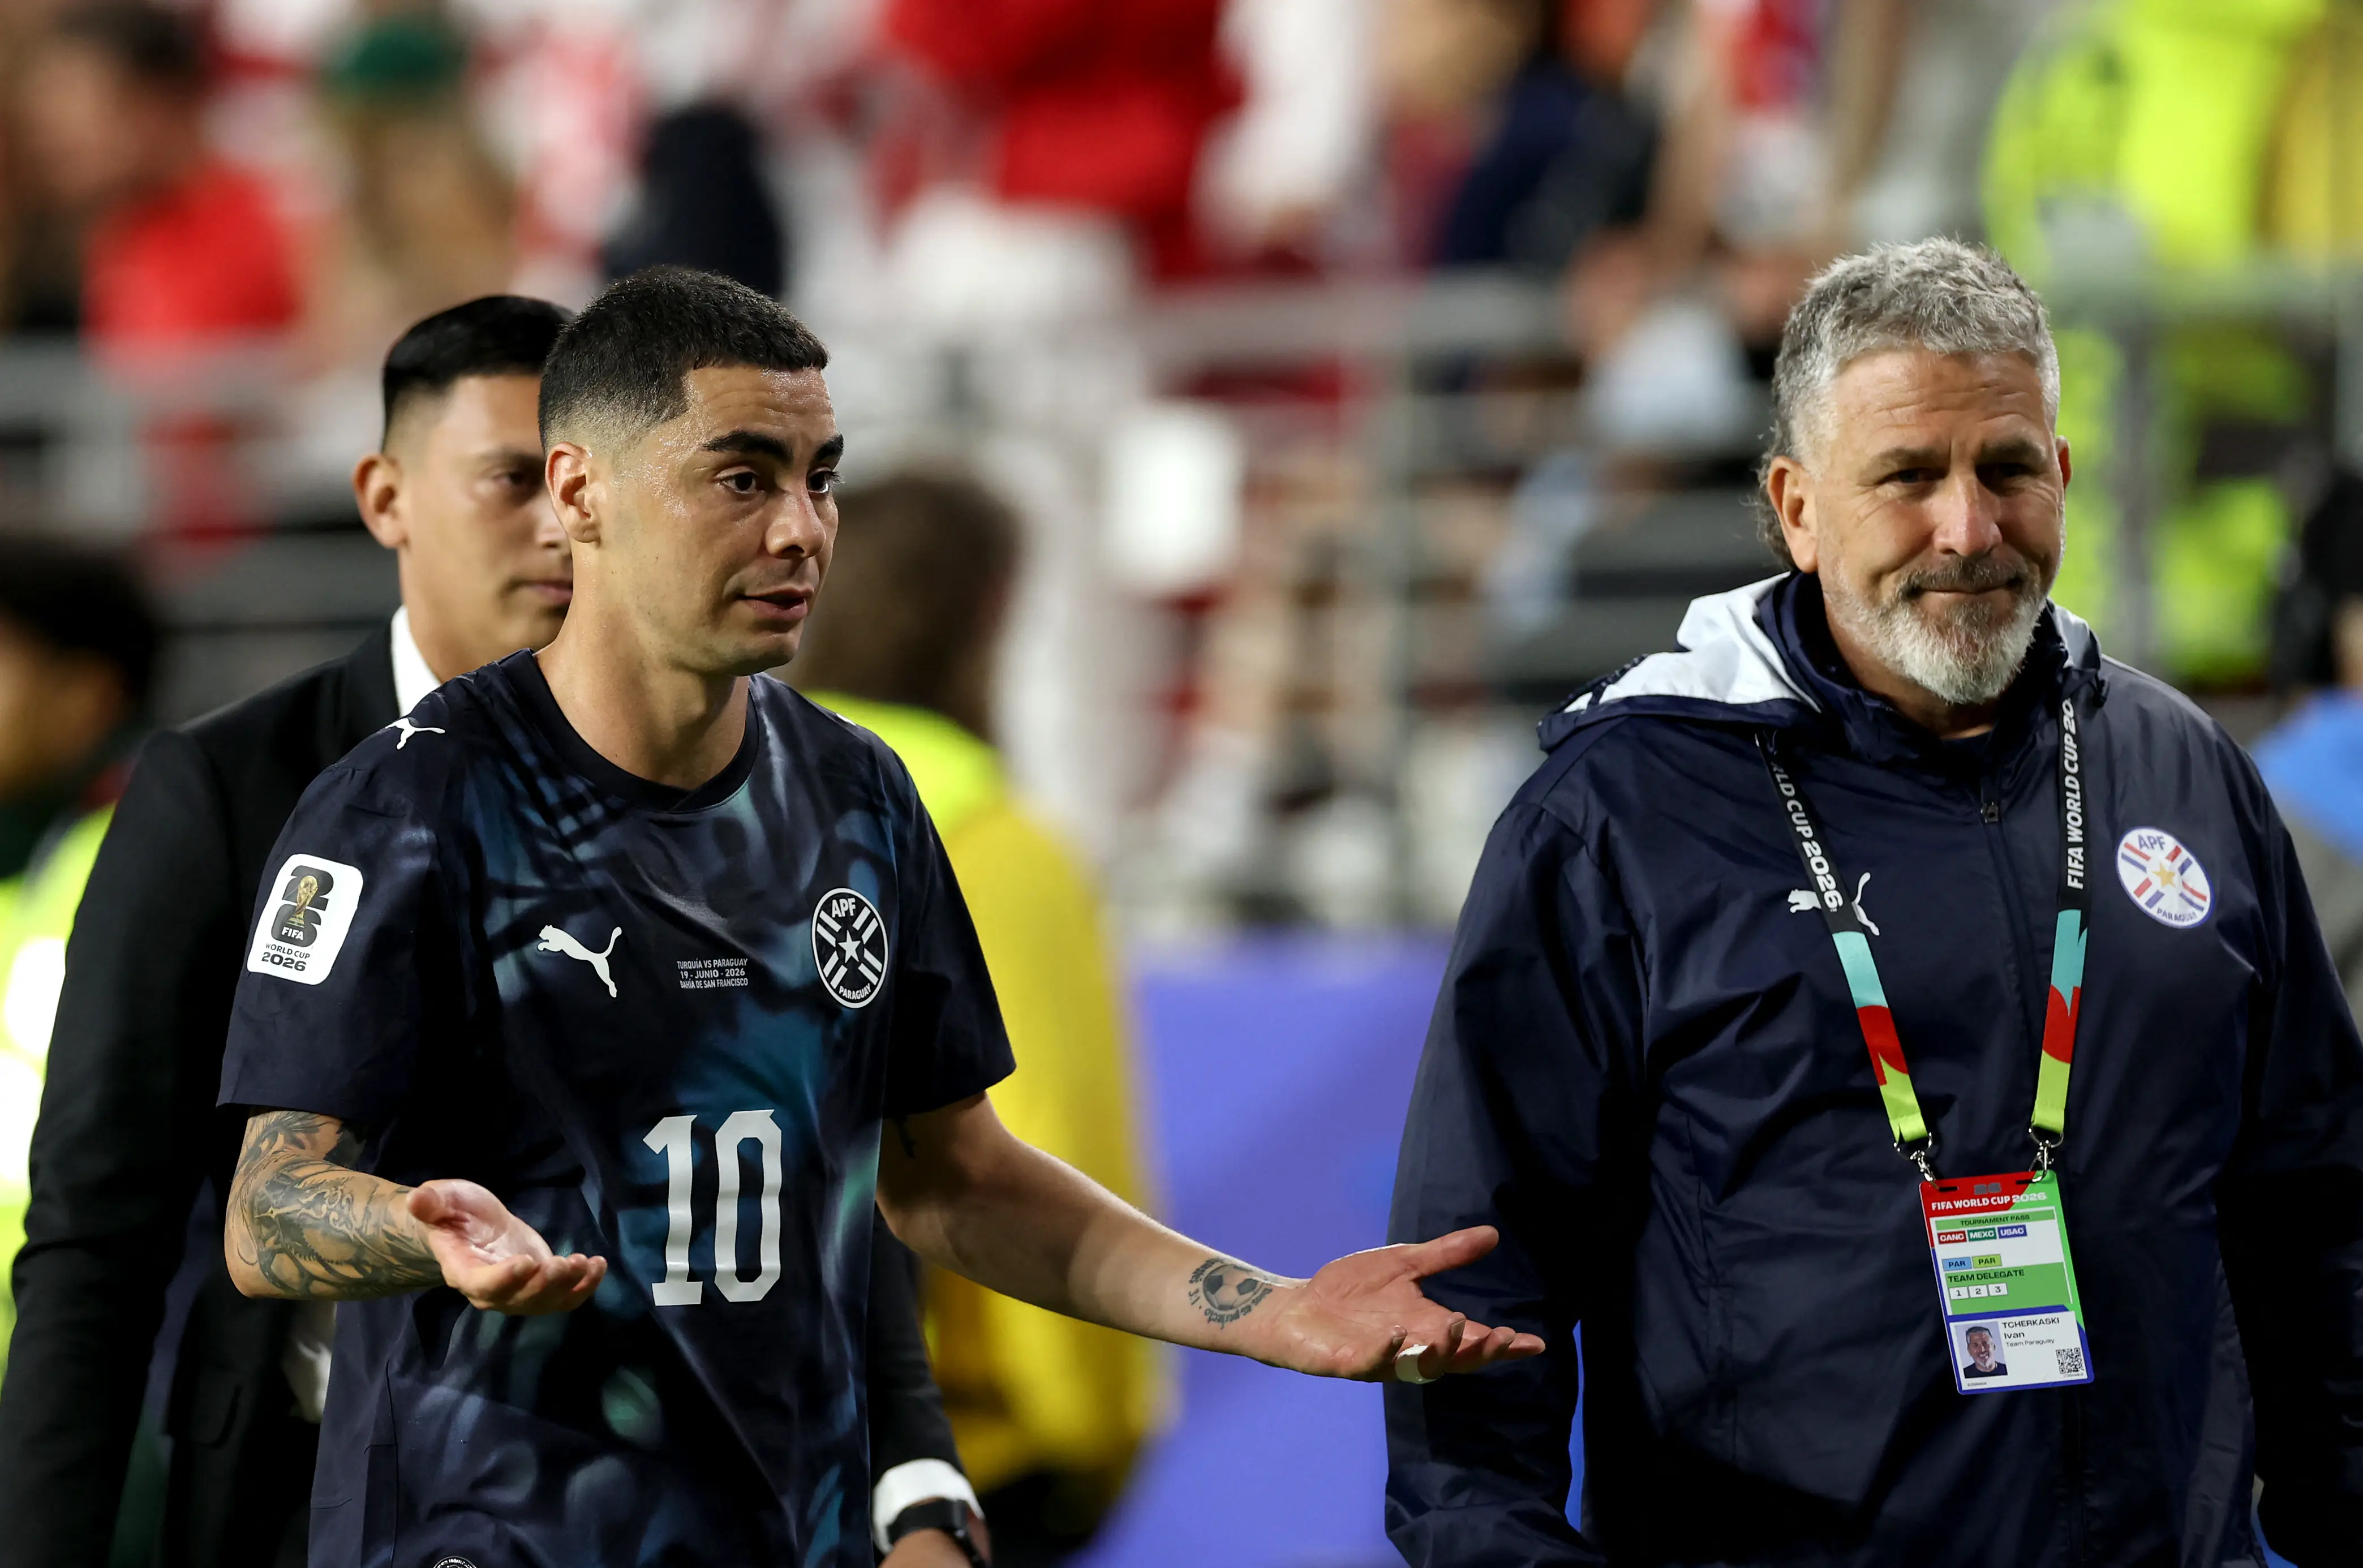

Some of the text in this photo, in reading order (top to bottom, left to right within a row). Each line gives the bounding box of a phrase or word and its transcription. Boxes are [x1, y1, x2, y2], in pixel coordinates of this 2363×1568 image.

[2063, 698, 2084, 890] FIFA WORLD CUP 20
[2137, 834, 2166, 850] APF
[1786, 800, 1814, 839] CUP
[1802, 840, 1844, 909] 2026
[832, 897, 856, 918] APF
[281, 926, 304, 940] FIFA
[265, 943, 310, 960] WORLD CUP
[261, 951, 307, 972] 2026
[677, 958, 748, 969] TURQUÍA VS PARAGUAY
[680, 970, 689, 979] 19
[695, 969, 719, 978] JUNIO
[725, 968, 745, 977] 2026
[680, 978, 695, 989] BAHÍA
[703, 980, 716, 988] SAN
[716, 978, 748, 987] FRANCISCO
[839, 983, 871, 1000] PARAGUAY
[642, 1109, 782, 1306] 10
[1931, 1192, 2047, 1210] FIFA WORLD CUP 2026
[1960, 1217, 2009, 1226] TOURNAMENT
[1948, 1269, 2025, 1283] TEAM DELEGATE
[2002, 1317, 2060, 1329] TCHERKASKI
